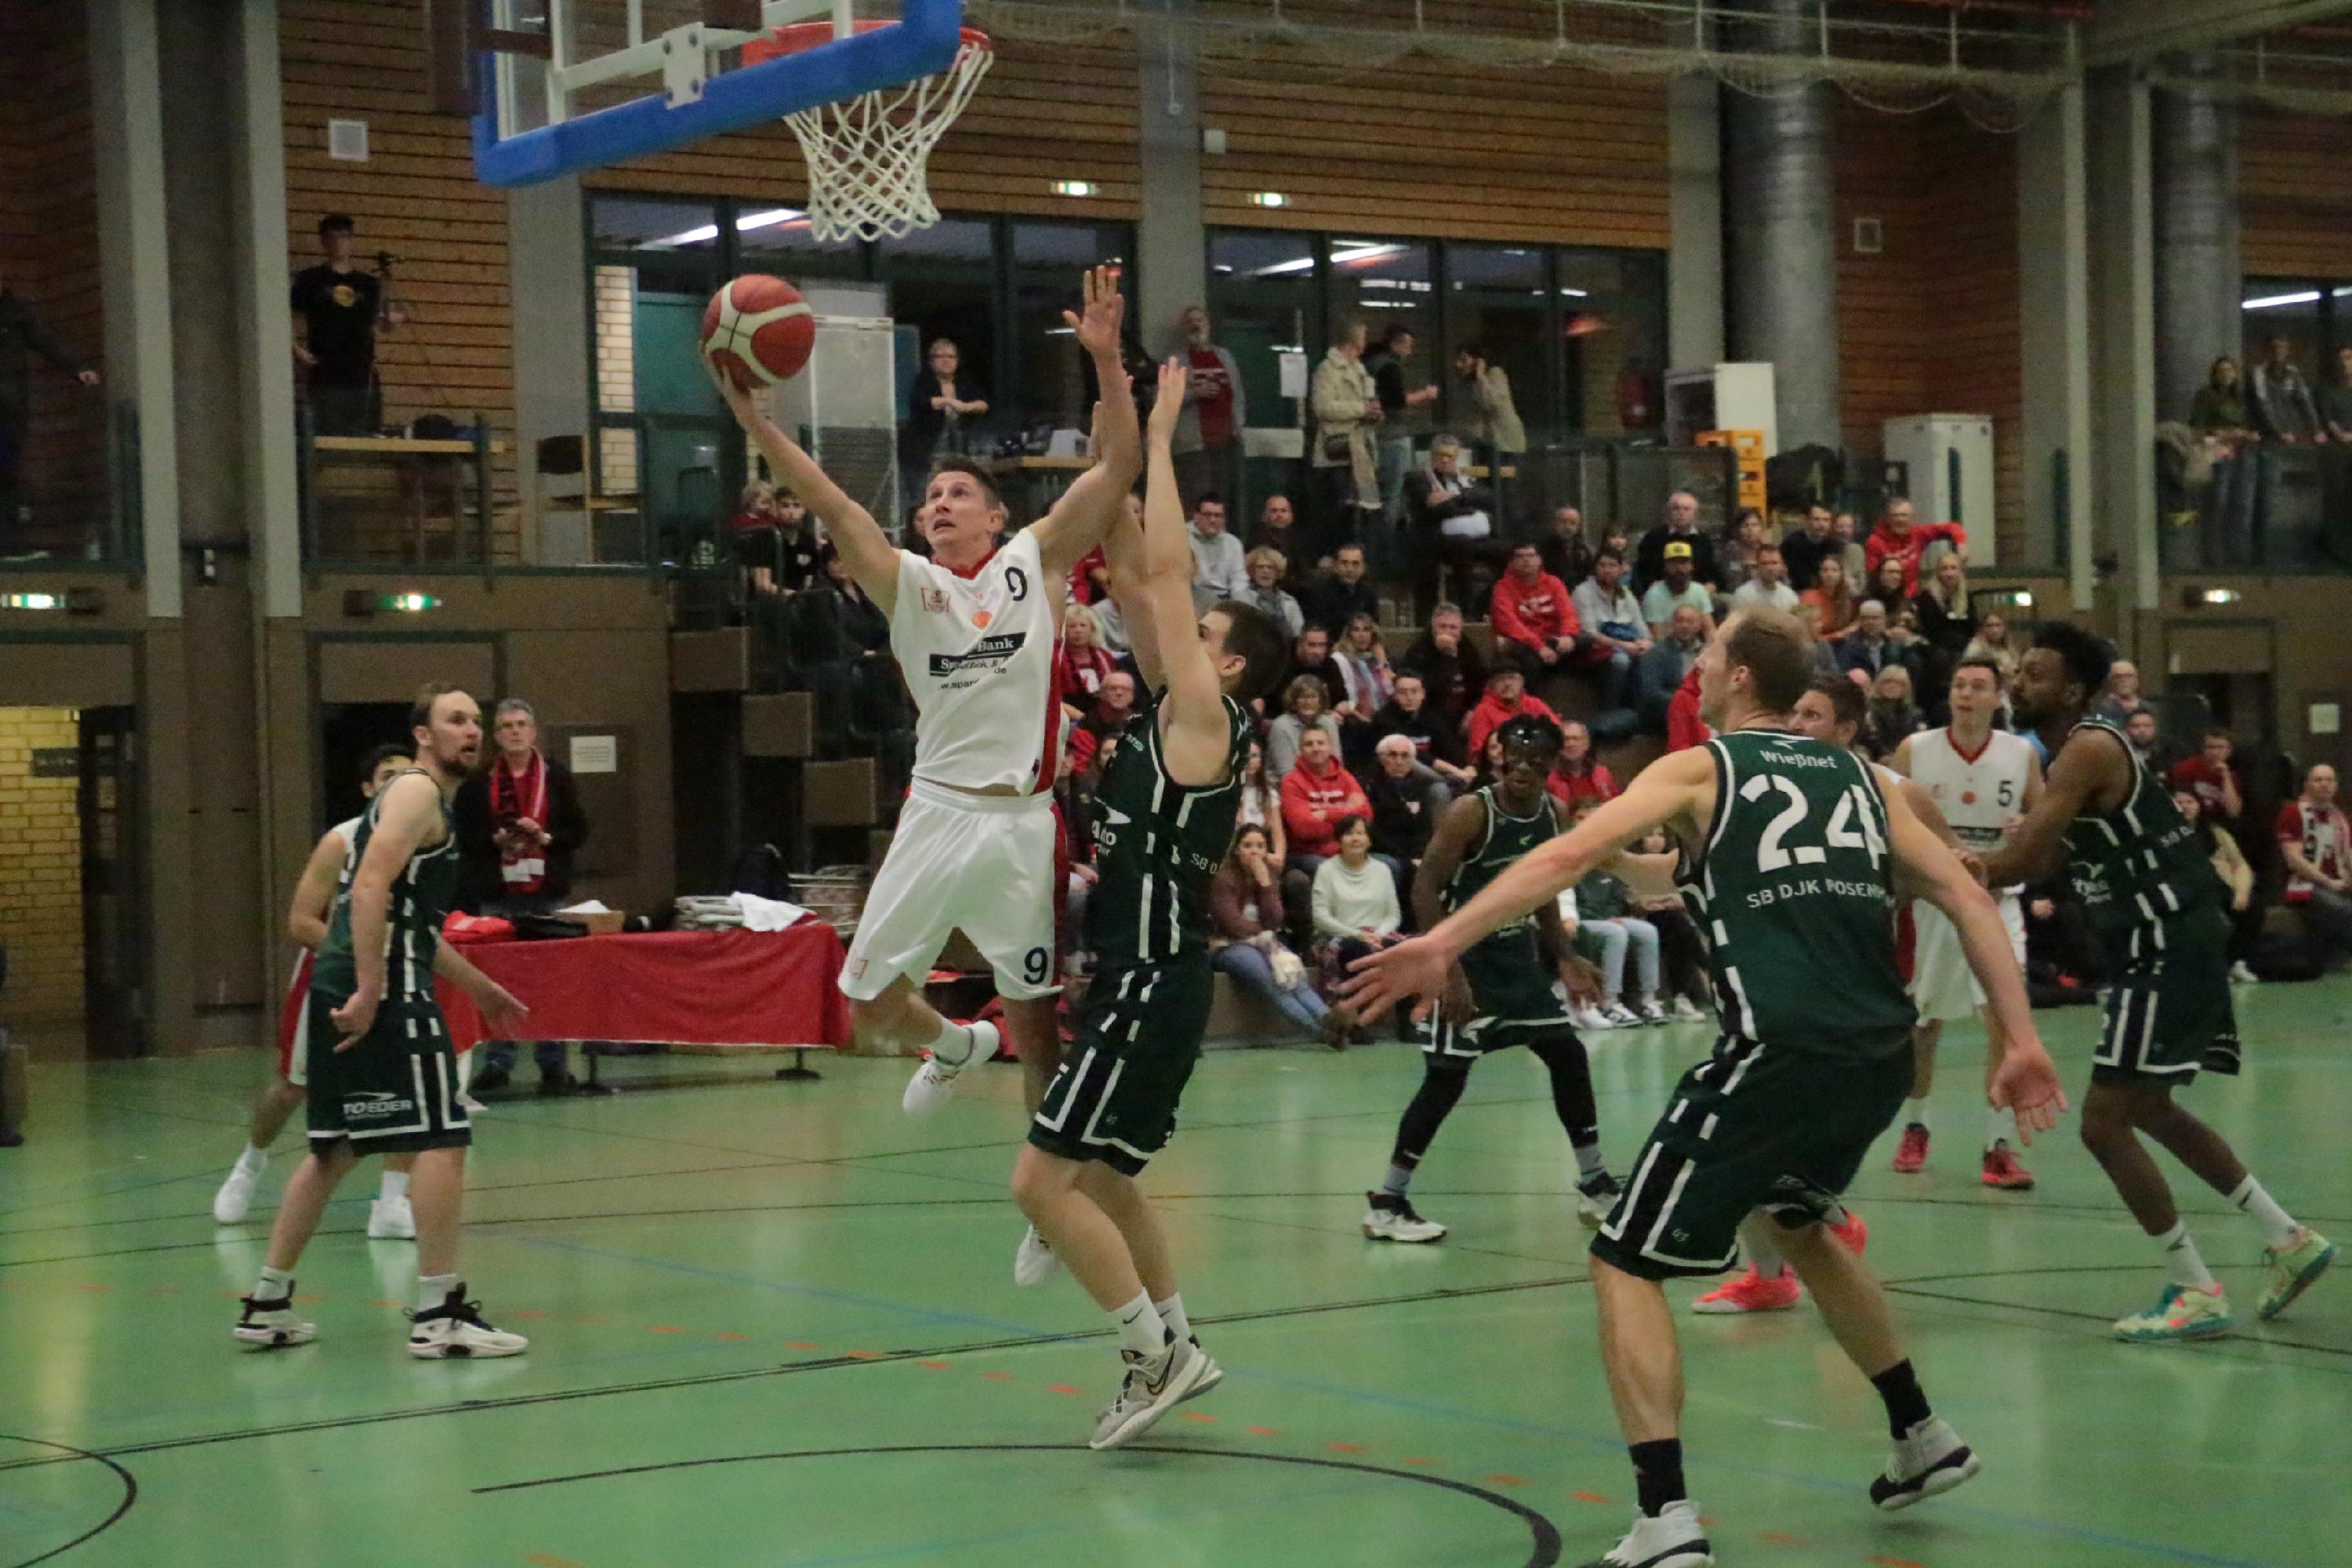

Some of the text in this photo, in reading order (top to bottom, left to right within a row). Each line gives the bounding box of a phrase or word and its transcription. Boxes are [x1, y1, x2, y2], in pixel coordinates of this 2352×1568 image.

[1004, 566, 1028, 601] 9
[1998, 780, 2012, 808] 5
[1738, 773, 1888, 873] 24
[1746, 888, 1776, 909] SB
[1778, 878, 1822, 899] DJK
[1024, 946, 1049, 985] 9
